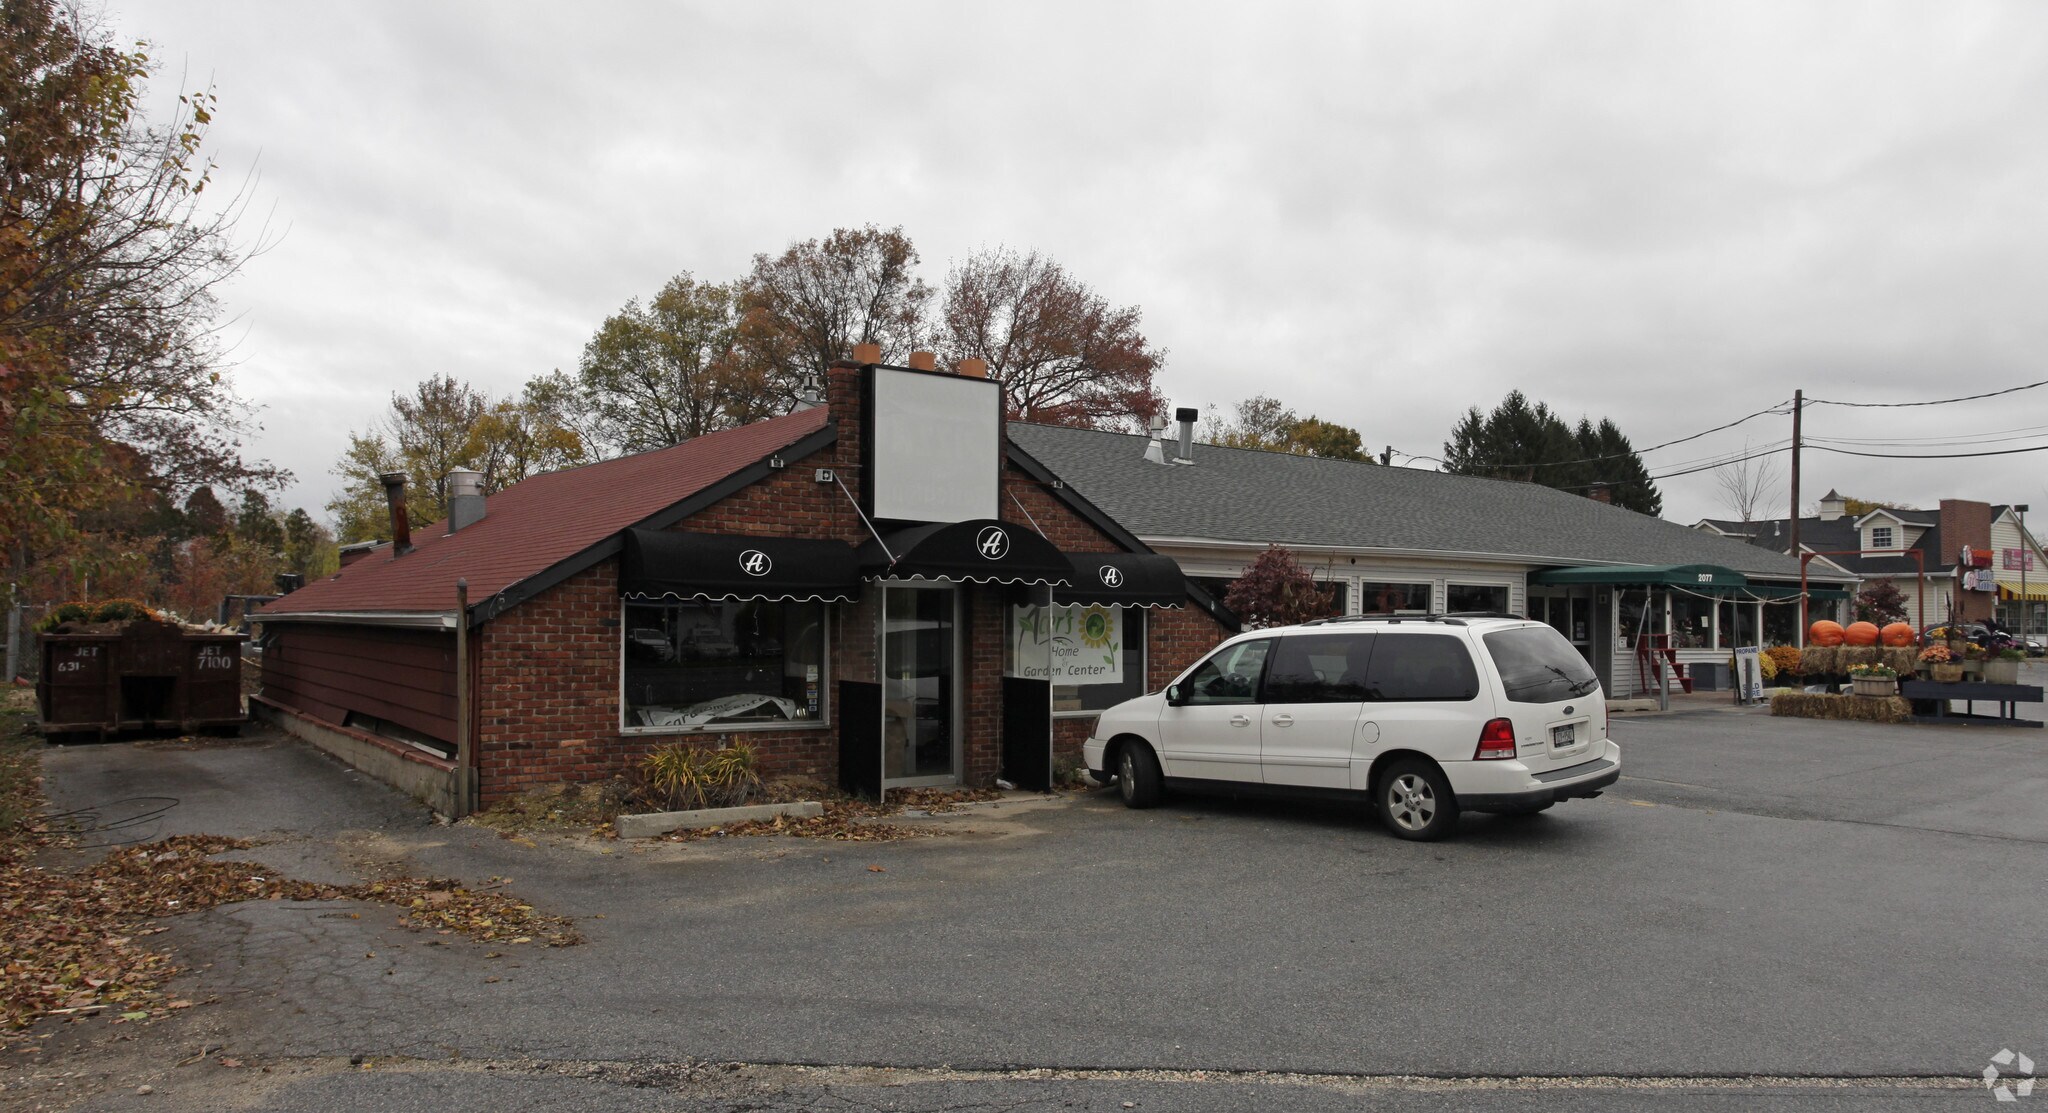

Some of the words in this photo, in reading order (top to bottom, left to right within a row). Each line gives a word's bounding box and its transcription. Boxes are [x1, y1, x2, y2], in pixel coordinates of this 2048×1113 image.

[982, 531, 1002, 555] A
[745, 553, 763, 572] A
[1104, 568, 1118, 584] A
[1697, 573, 1713, 583] 2077
[73, 646, 98, 657] JET
[199, 645, 221, 656] JET
[1735, 647, 1758, 655] PROPANE
[197, 656, 231, 670] 7100
[1067, 664, 1106, 676] Center
